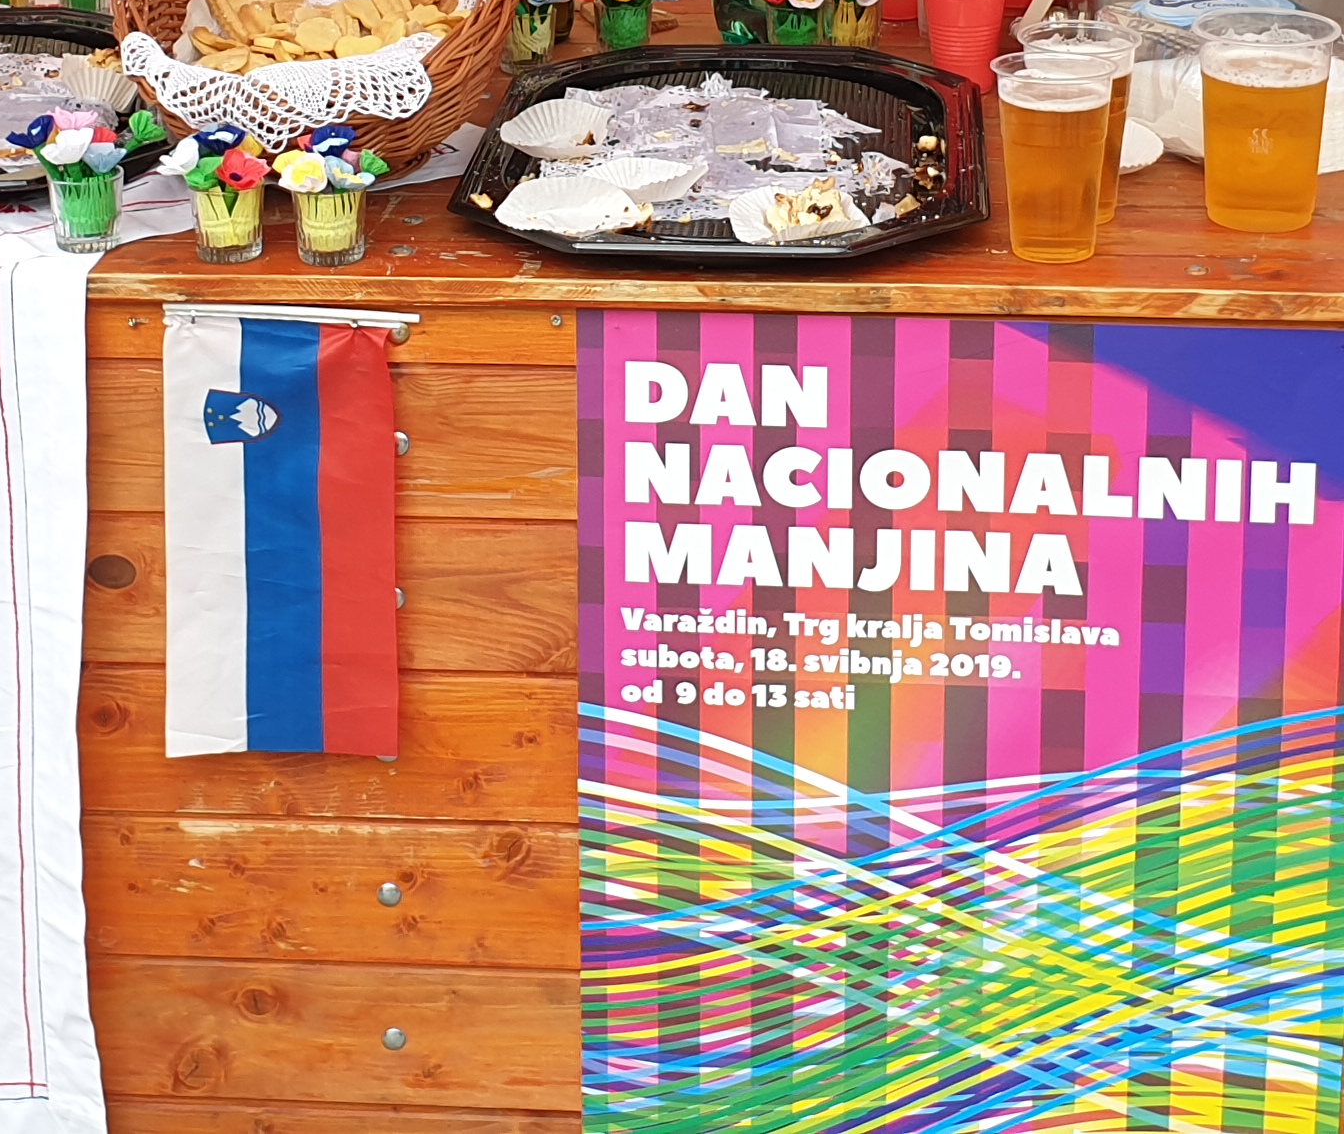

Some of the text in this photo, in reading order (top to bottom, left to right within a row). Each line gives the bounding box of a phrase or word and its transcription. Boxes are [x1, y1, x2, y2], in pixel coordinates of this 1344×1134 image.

[625, 361, 829, 429] DAN
[625, 441, 1318, 526] NACIONALNIH
[624, 521, 1084, 597] MANJINA
[621, 606, 1121, 649] Varaždin, Trg kralja Tomislava
[621, 644, 1022, 687] subota, 18. svibnja 2019.
[621, 679, 856, 711] od 9 do 13 sati
